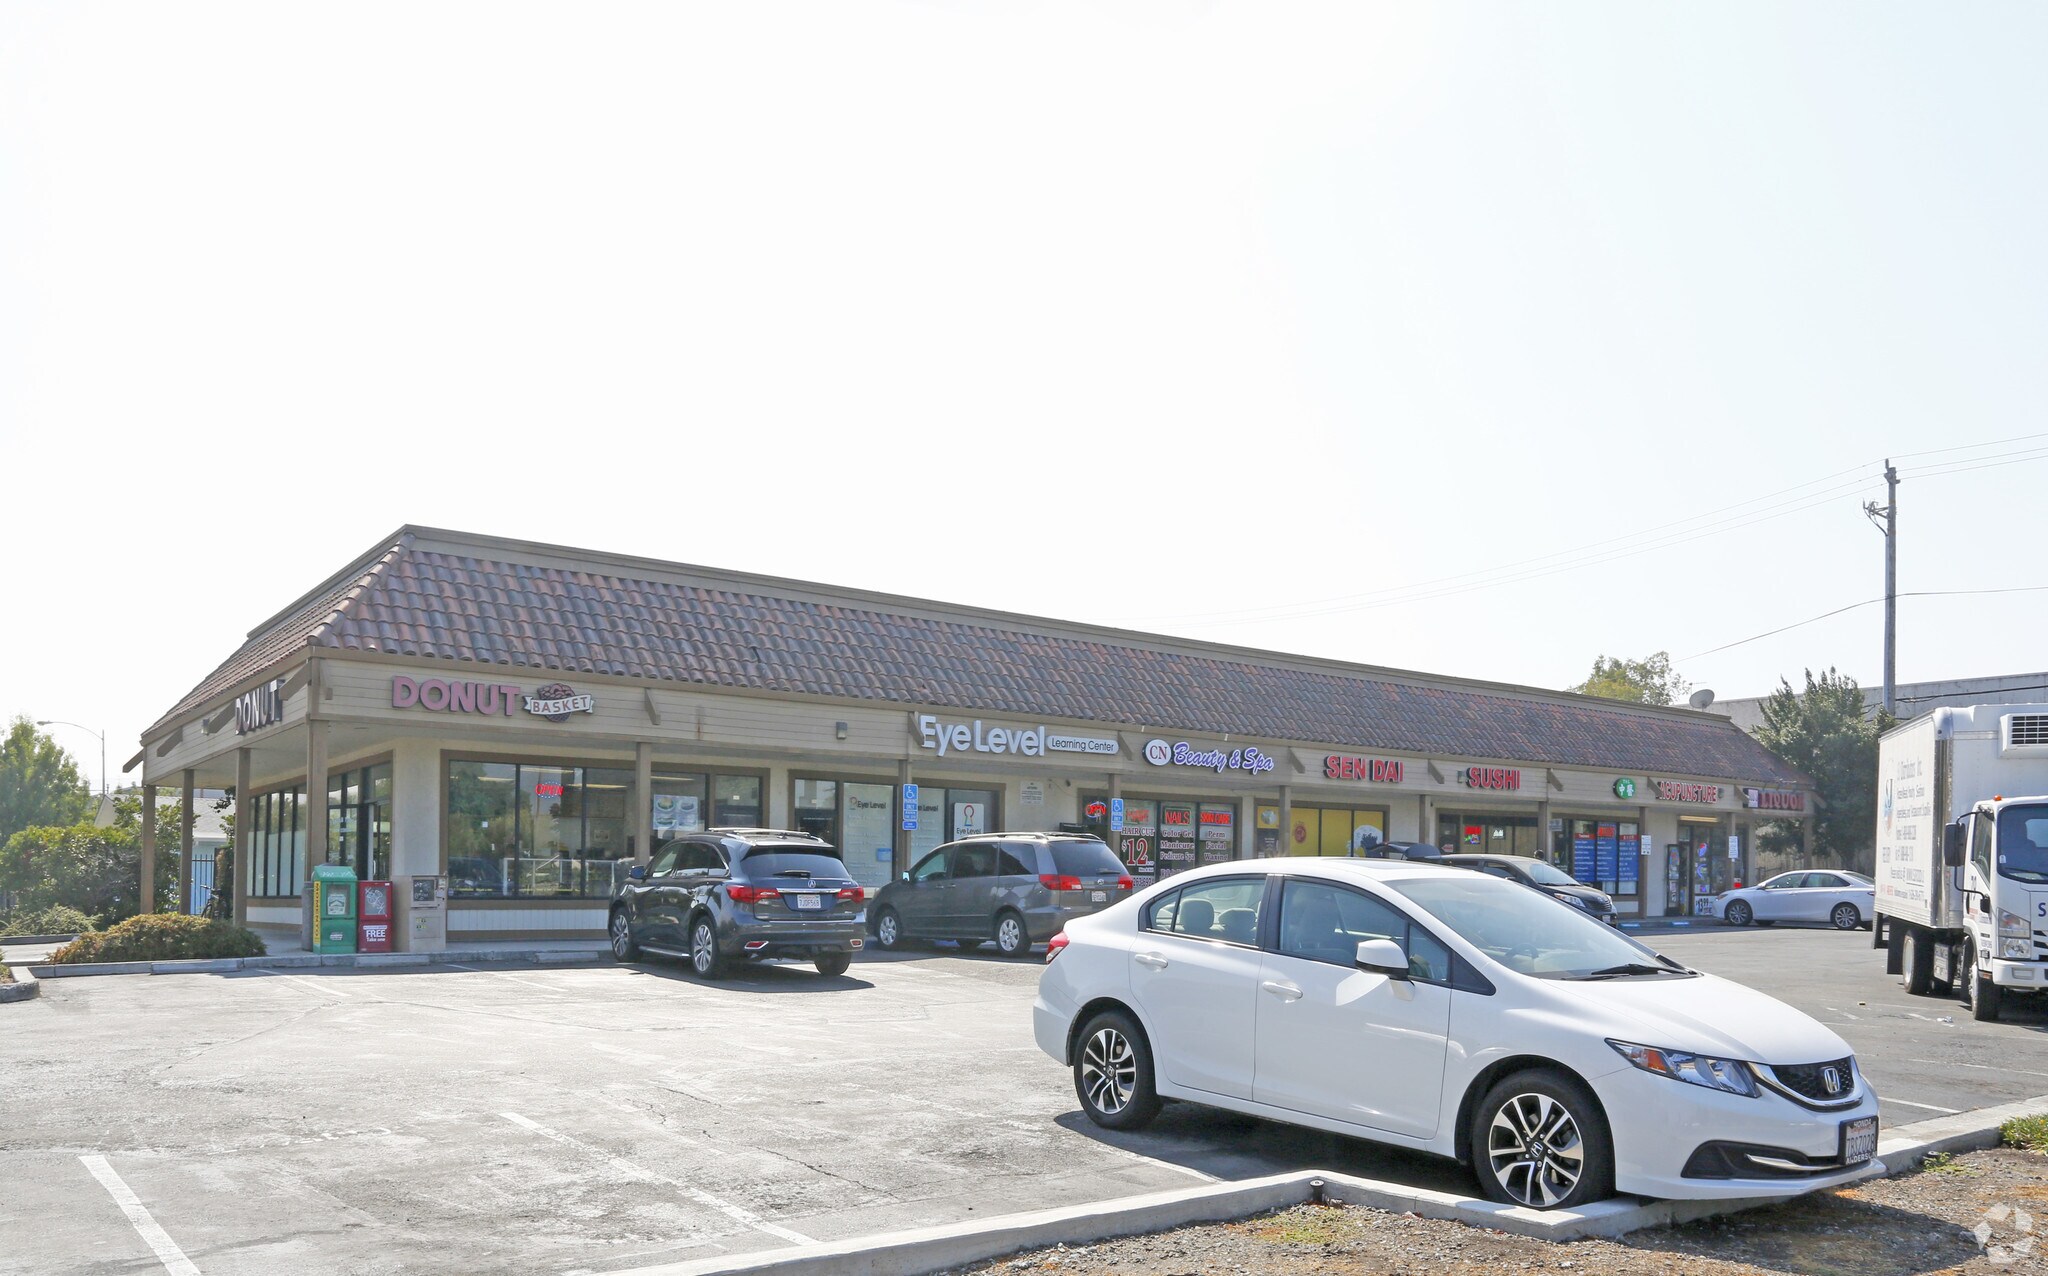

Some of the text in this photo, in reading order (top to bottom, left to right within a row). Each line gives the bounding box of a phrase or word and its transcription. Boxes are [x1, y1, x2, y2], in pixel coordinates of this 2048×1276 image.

[392, 676, 521, 716] DONUT
[235, 679, 285, 735] DONUT
[533, 696, 588, 713] BASKET
[920, 715, 1045, 757] Eye Level
[1052, 737, 1114, 752] Learning Center
[1149, 745, 1168, 760] CN
[1173, 742, 1275, 775] Beauty & Spa
[1325, 755, 1404, 783] SEN DAI
[1467, 767, 1520, 790] SUSHI
[535, 784, 565, 796] OPEN
[1658, 780, 1718, 804] ACUPUNCTURE
[857, 801, 869, 809] Eye
[1086, 804, 1106, 815] OPEN
[1165, 811, 1189, 825] NAILS
[1201, 812, 1230, 825] SKIN CARE
[1121, 827, 1155, 837] HAIR CUT
[1162, 829, 1181, 838] Color
[1122, 838, 1148, 866] $12
[1161, 841, 1195, 850] Manicure
[1206, 841, 1226, 850] Facial
[1161, 851, 1184, 861] Pedicure
[1204, 852, 1228, 862] Waxing
[366, 929, 386, 938] FREE
[1854, 1118, 1872, 1128] HONDA
